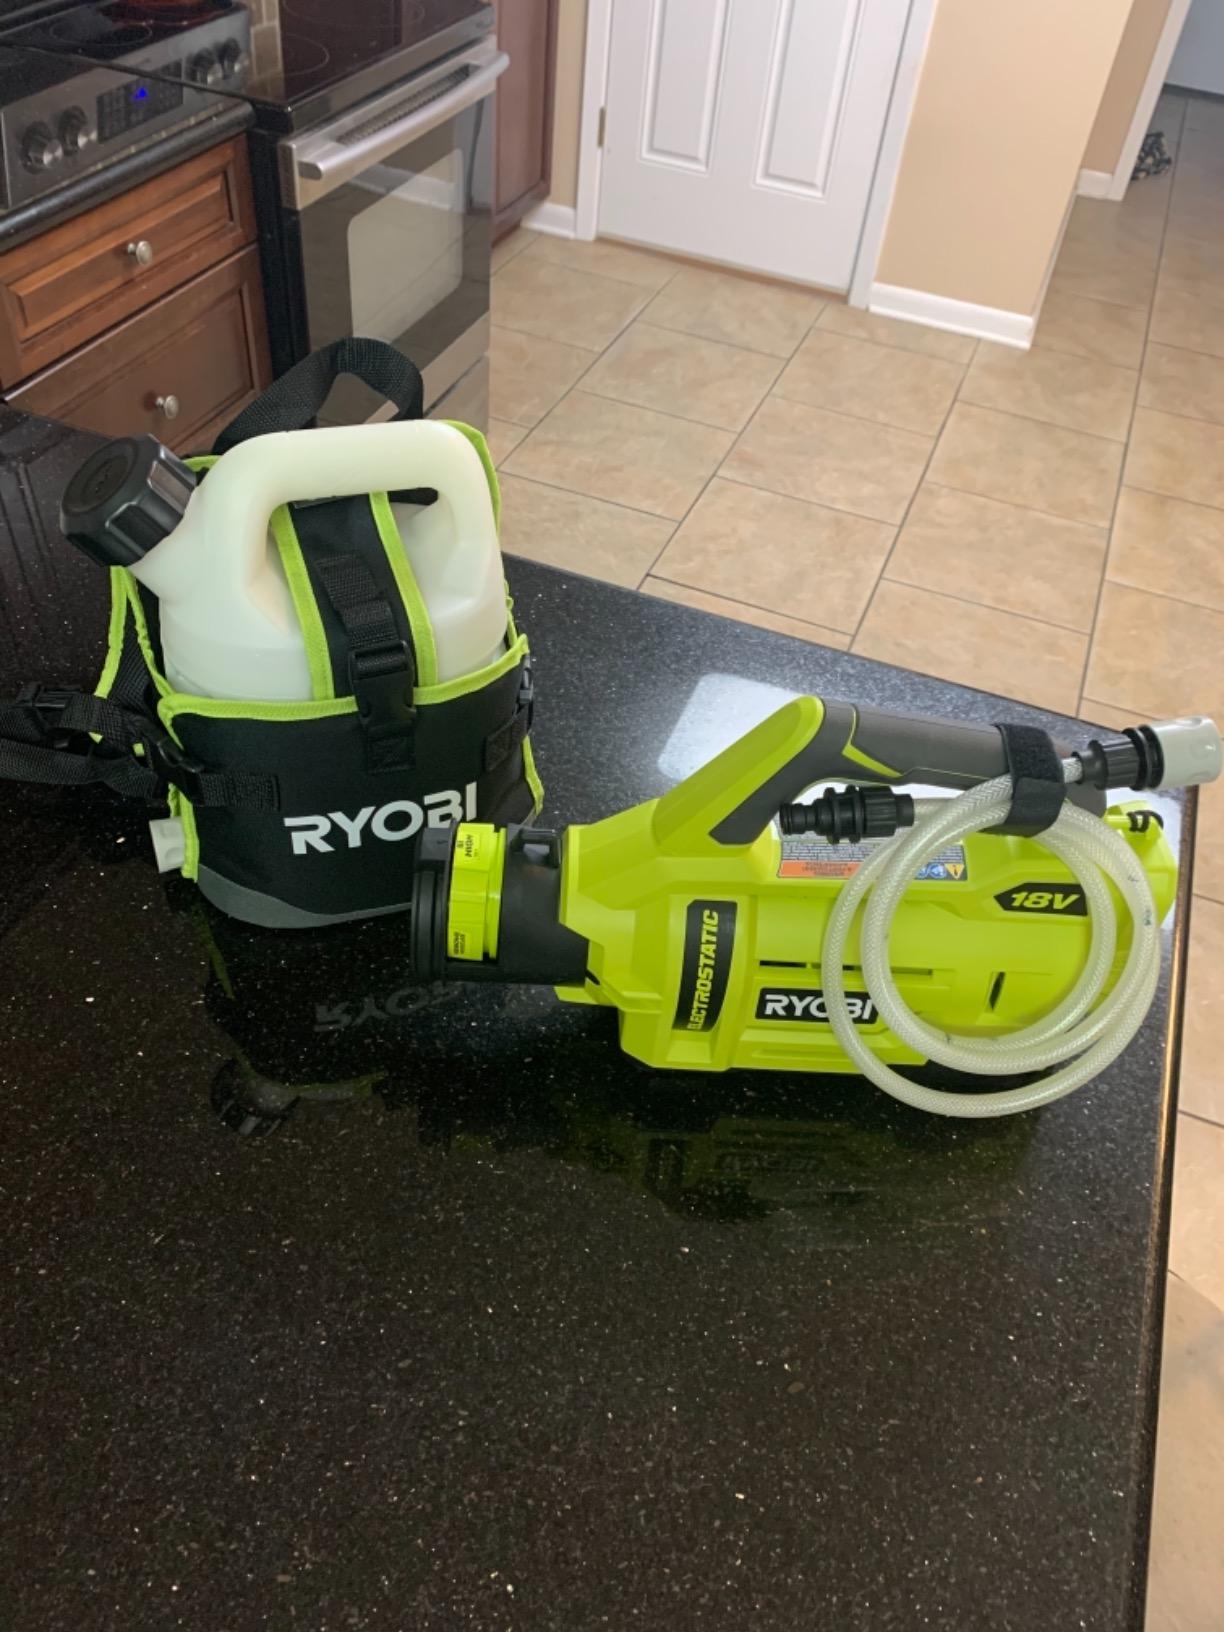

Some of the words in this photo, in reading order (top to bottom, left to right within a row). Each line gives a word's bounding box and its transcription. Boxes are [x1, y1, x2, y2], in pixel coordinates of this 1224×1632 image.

[283, 781, 477, 855] RYOBI
[1011, 891, 1080, 910] 18V
[686, 909, 719, 1031] ELECTROSTATIC
